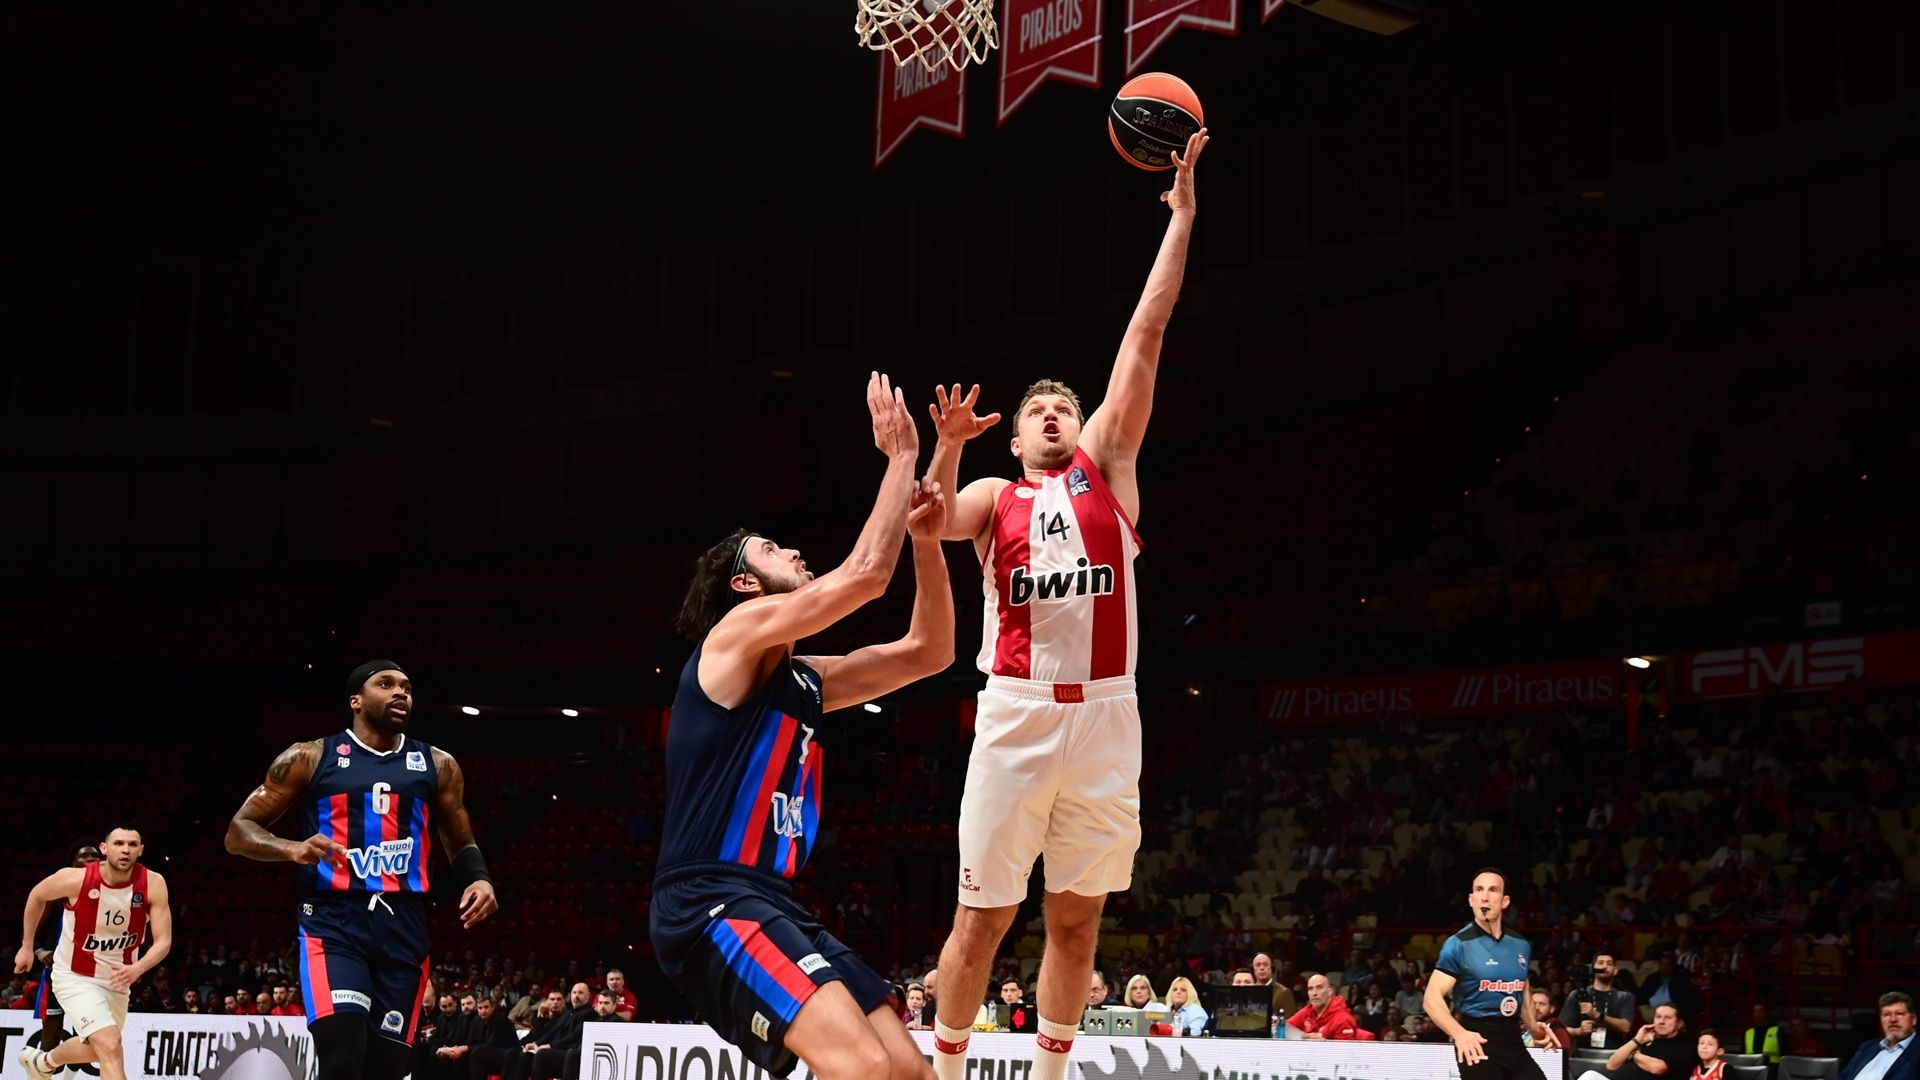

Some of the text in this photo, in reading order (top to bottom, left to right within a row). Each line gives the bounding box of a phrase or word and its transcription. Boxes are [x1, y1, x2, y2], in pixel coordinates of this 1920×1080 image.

[1018, 0, 1083, 54] PIRAEUS
[1038, 511, 1071, 543] 14
[1011, 556, 1115, 606] bwin
[1691, 637, 1865, 696] FMS
[1303, 685, 1413, 717] Piraeus
[1491, 670, 1614, 706] Piraeus
[371, 782, 391, 815] 6
[347, 846, 411, 878] Viva
[104, 909, 125, 926] 16
[83, 931, 139, 952] bwin
